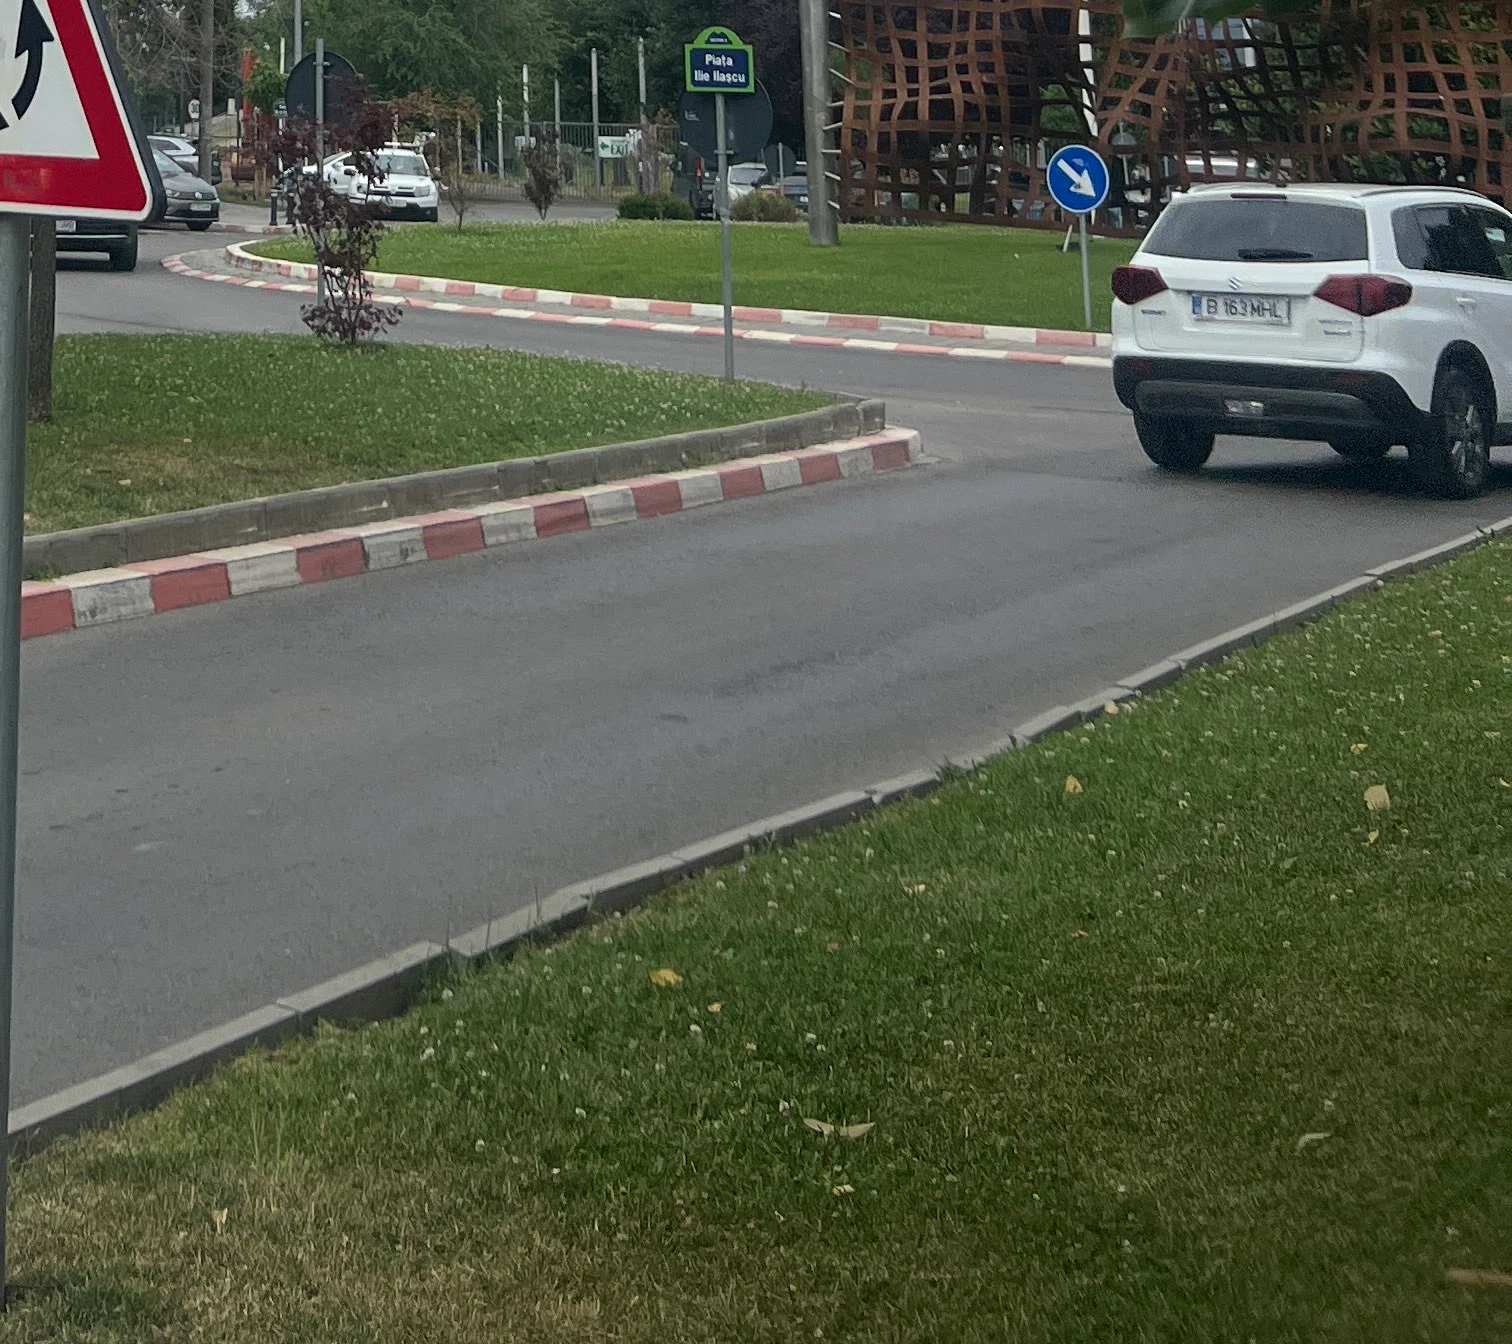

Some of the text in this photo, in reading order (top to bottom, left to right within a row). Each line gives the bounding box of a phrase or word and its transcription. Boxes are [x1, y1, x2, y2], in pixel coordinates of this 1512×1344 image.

[705, 53, 734, 68] Piața
[694, 69, 746, 85] Ilie Ilașcu
[1207, 298, 1218, 315] B
